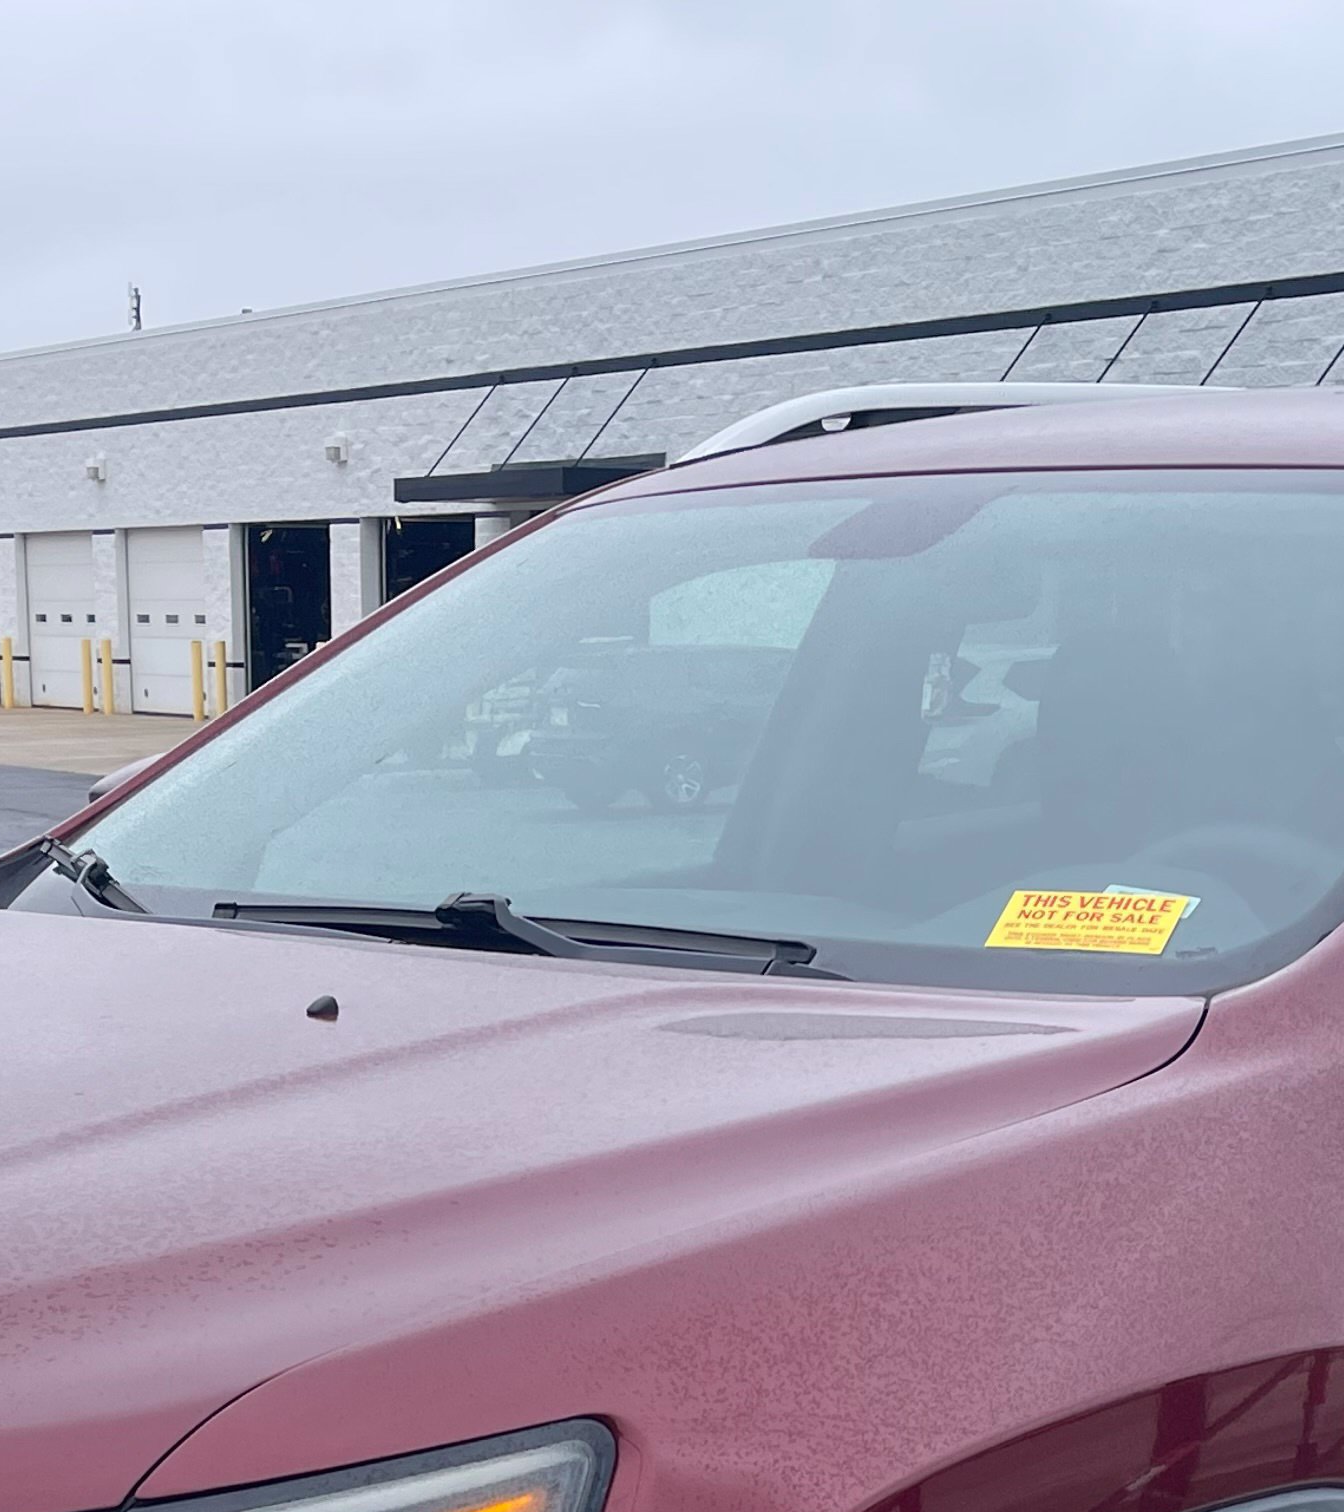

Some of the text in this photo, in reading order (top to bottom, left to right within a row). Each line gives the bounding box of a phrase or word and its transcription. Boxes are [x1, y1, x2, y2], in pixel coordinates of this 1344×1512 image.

[1022, 893, 1176, 913] THIS VEHICLE
[1017, 909, 1162, 925] NOT FOR SALE
